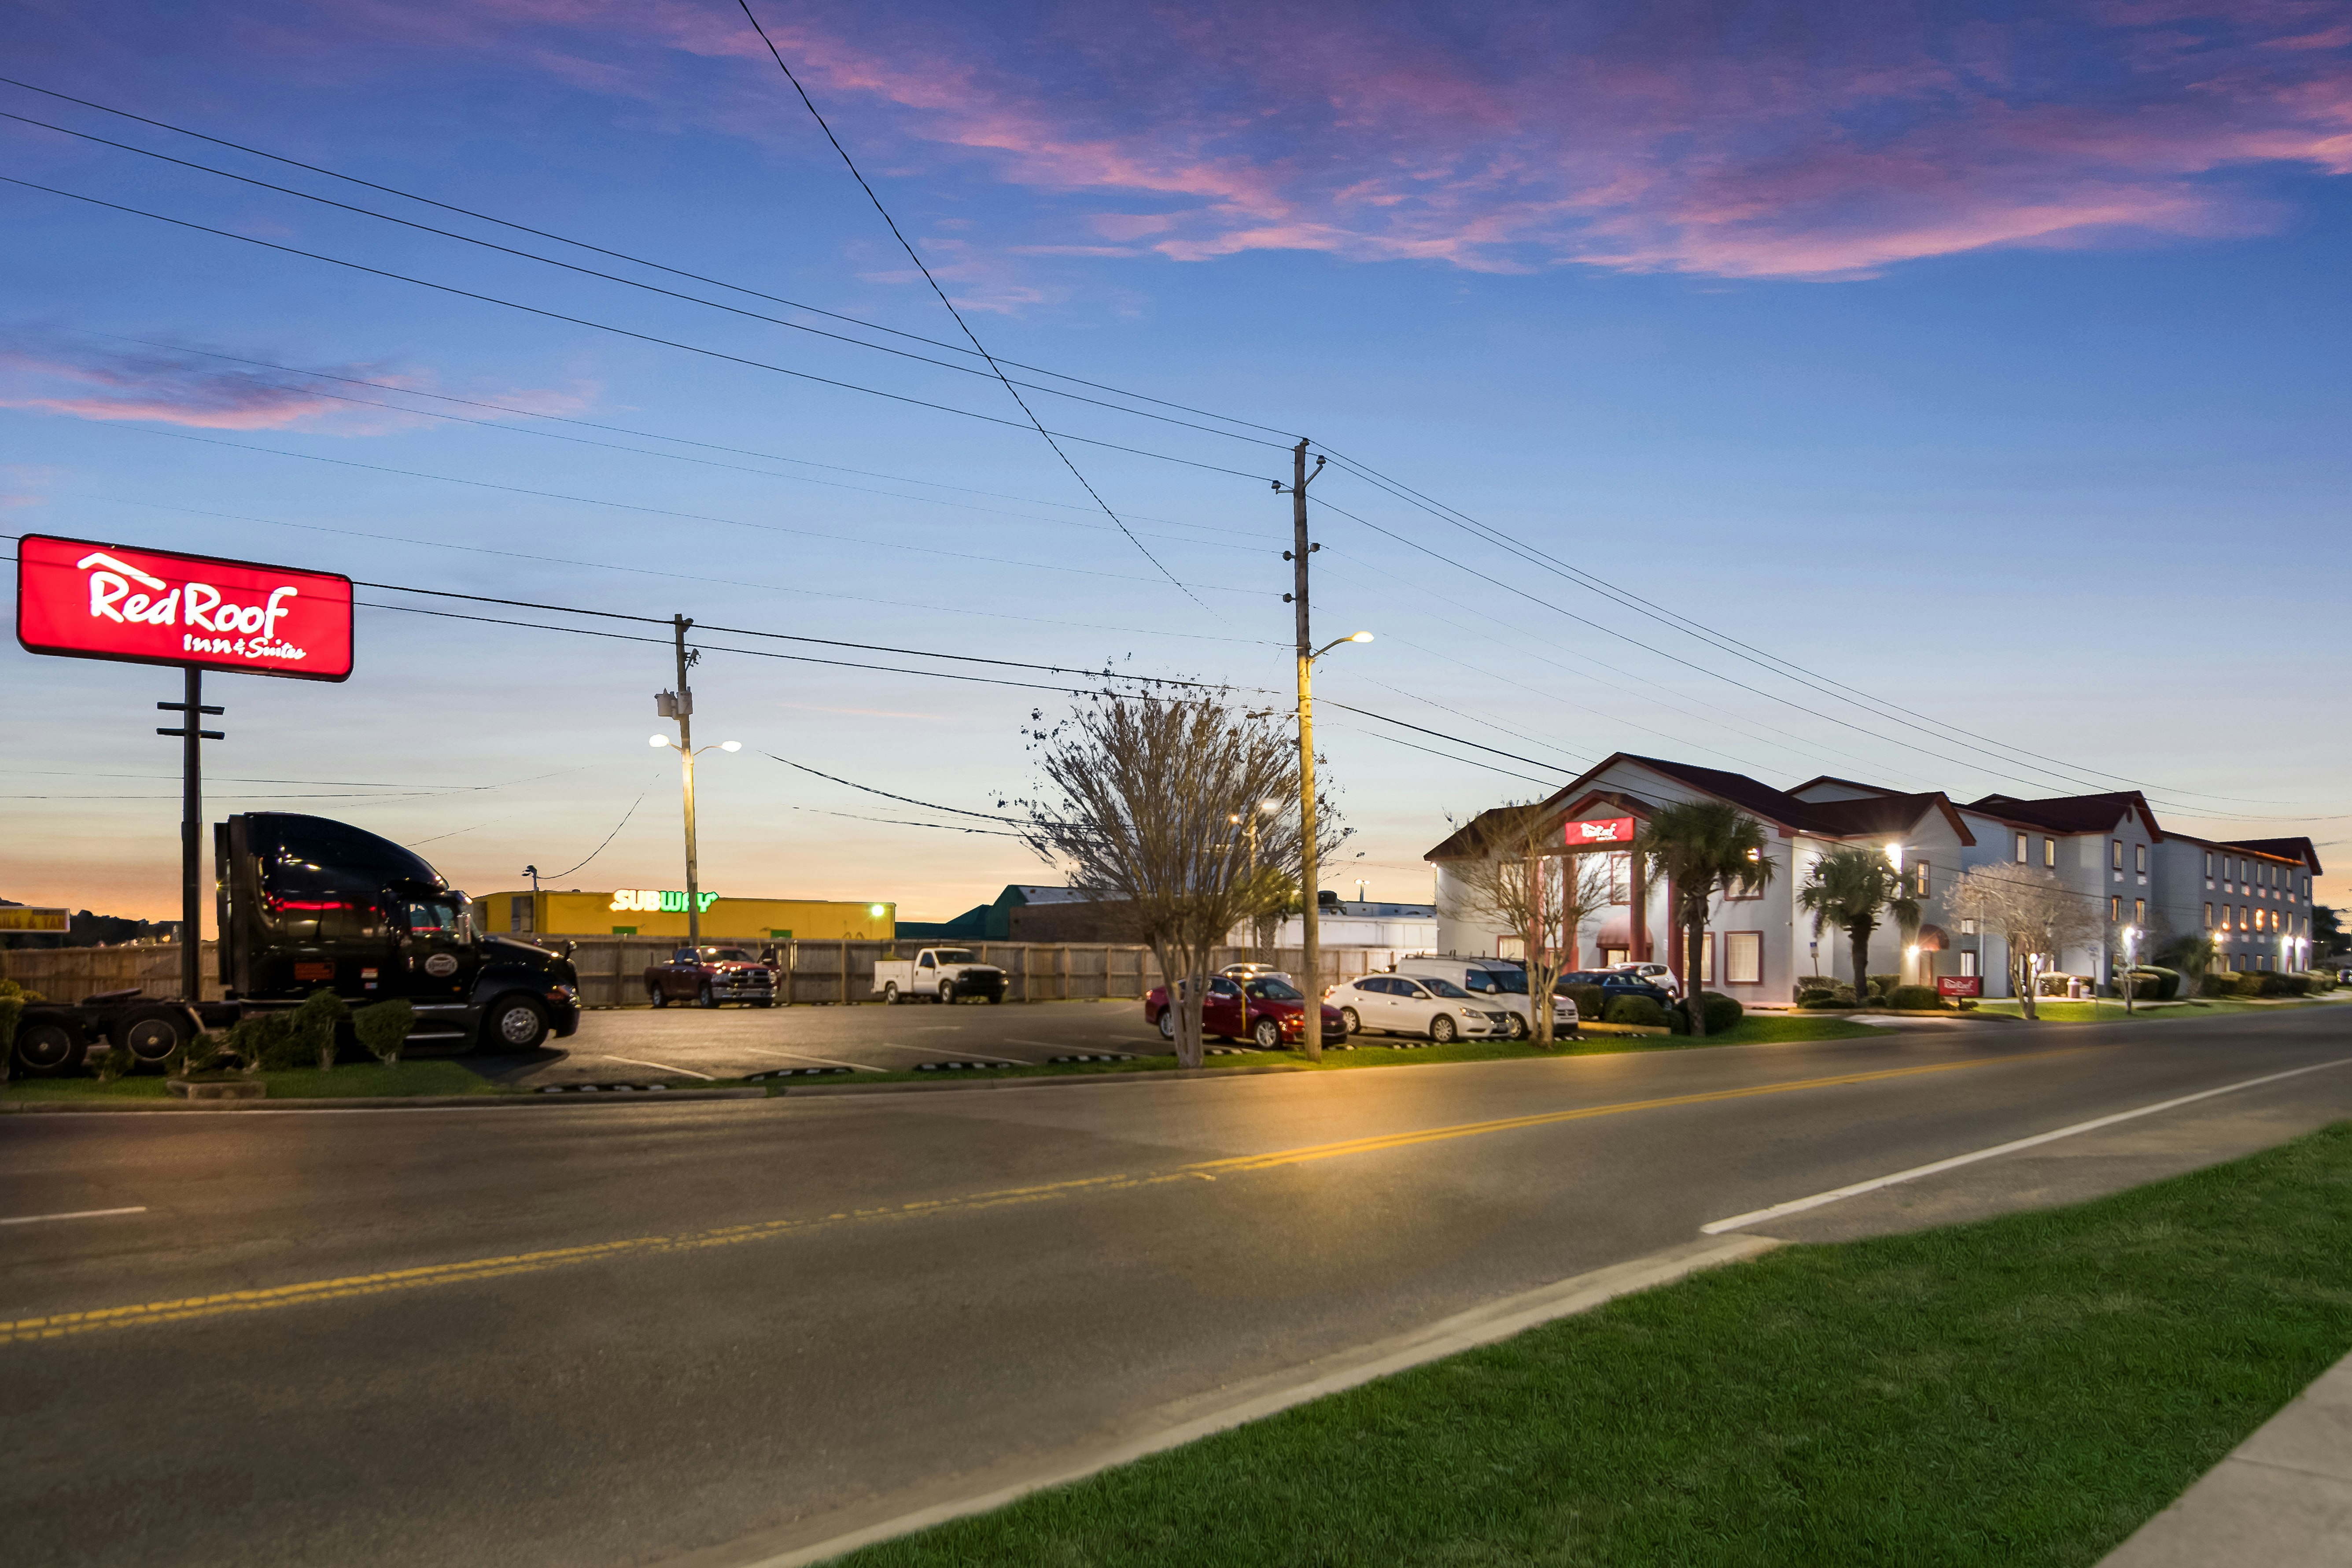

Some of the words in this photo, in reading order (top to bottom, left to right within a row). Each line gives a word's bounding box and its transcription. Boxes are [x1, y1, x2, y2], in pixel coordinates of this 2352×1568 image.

[90, 571, 181, 625] Red
[184, 582, 298, 639] Roof
[183, 633, 232, 654] Inn
[245, 637, 306, 660] Suites
